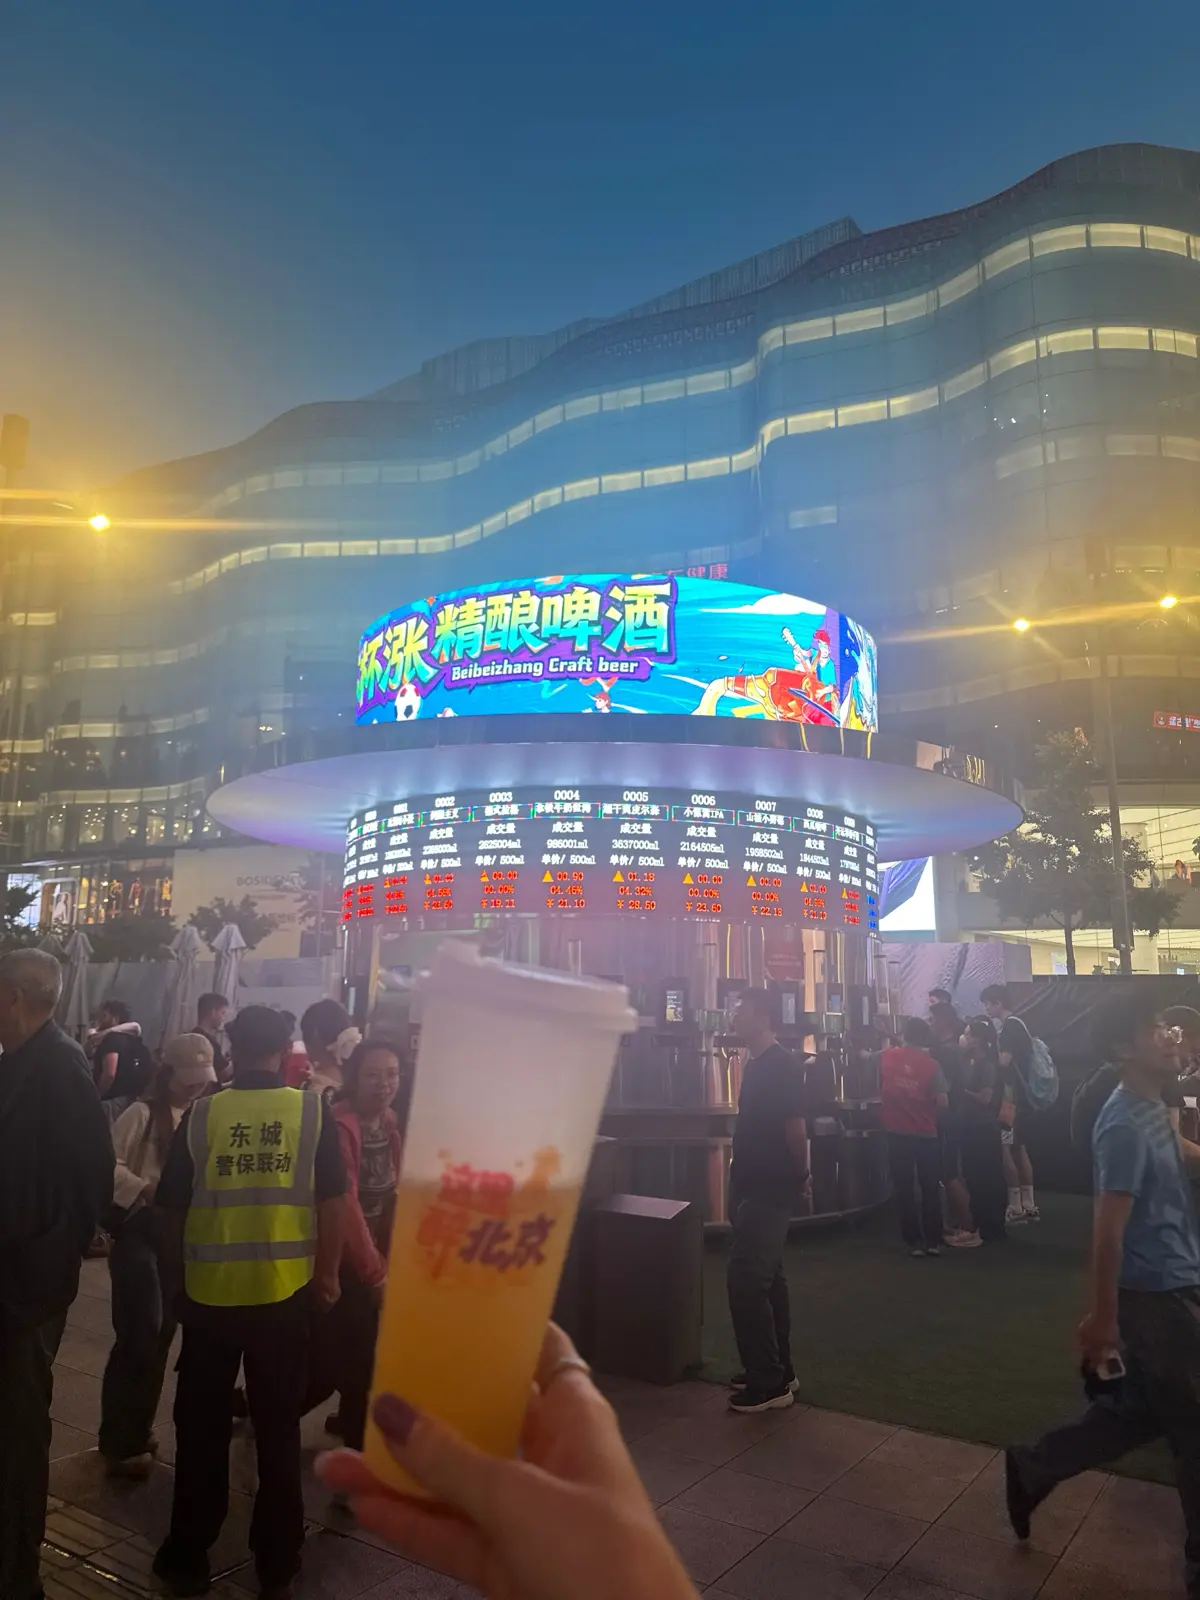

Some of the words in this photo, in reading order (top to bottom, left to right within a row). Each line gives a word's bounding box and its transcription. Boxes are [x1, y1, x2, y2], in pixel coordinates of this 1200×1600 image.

[452, 661, 543, 681] Beibeizhang
[548, 655, 592, 673] Craft
[598, 656, 638, 673] beer
[489, 791, 513, 802] 0003
[554, 790, 580, 800] 0004
[623, 791, 648, 801] 0005
[691, 794, 716, 805] 0006
[755, 800, 776, 811] 0007
[486, 822, 516, 835] 成交量
[552, 821, 584, 833] 成交量
[620, 822, 652, 834] 成交量
[686, 825, 717, 838] 成交量
[752, 832, 779, 844] 成交量
[570, 855, 596, 865] 500ml
[638, 856, 665, 867] 500ml
[705, 859, 729, 869] 500ml
[229, 1120, 282, 1148] 东城
[215, 1152, 292, 1177] 警保联动
